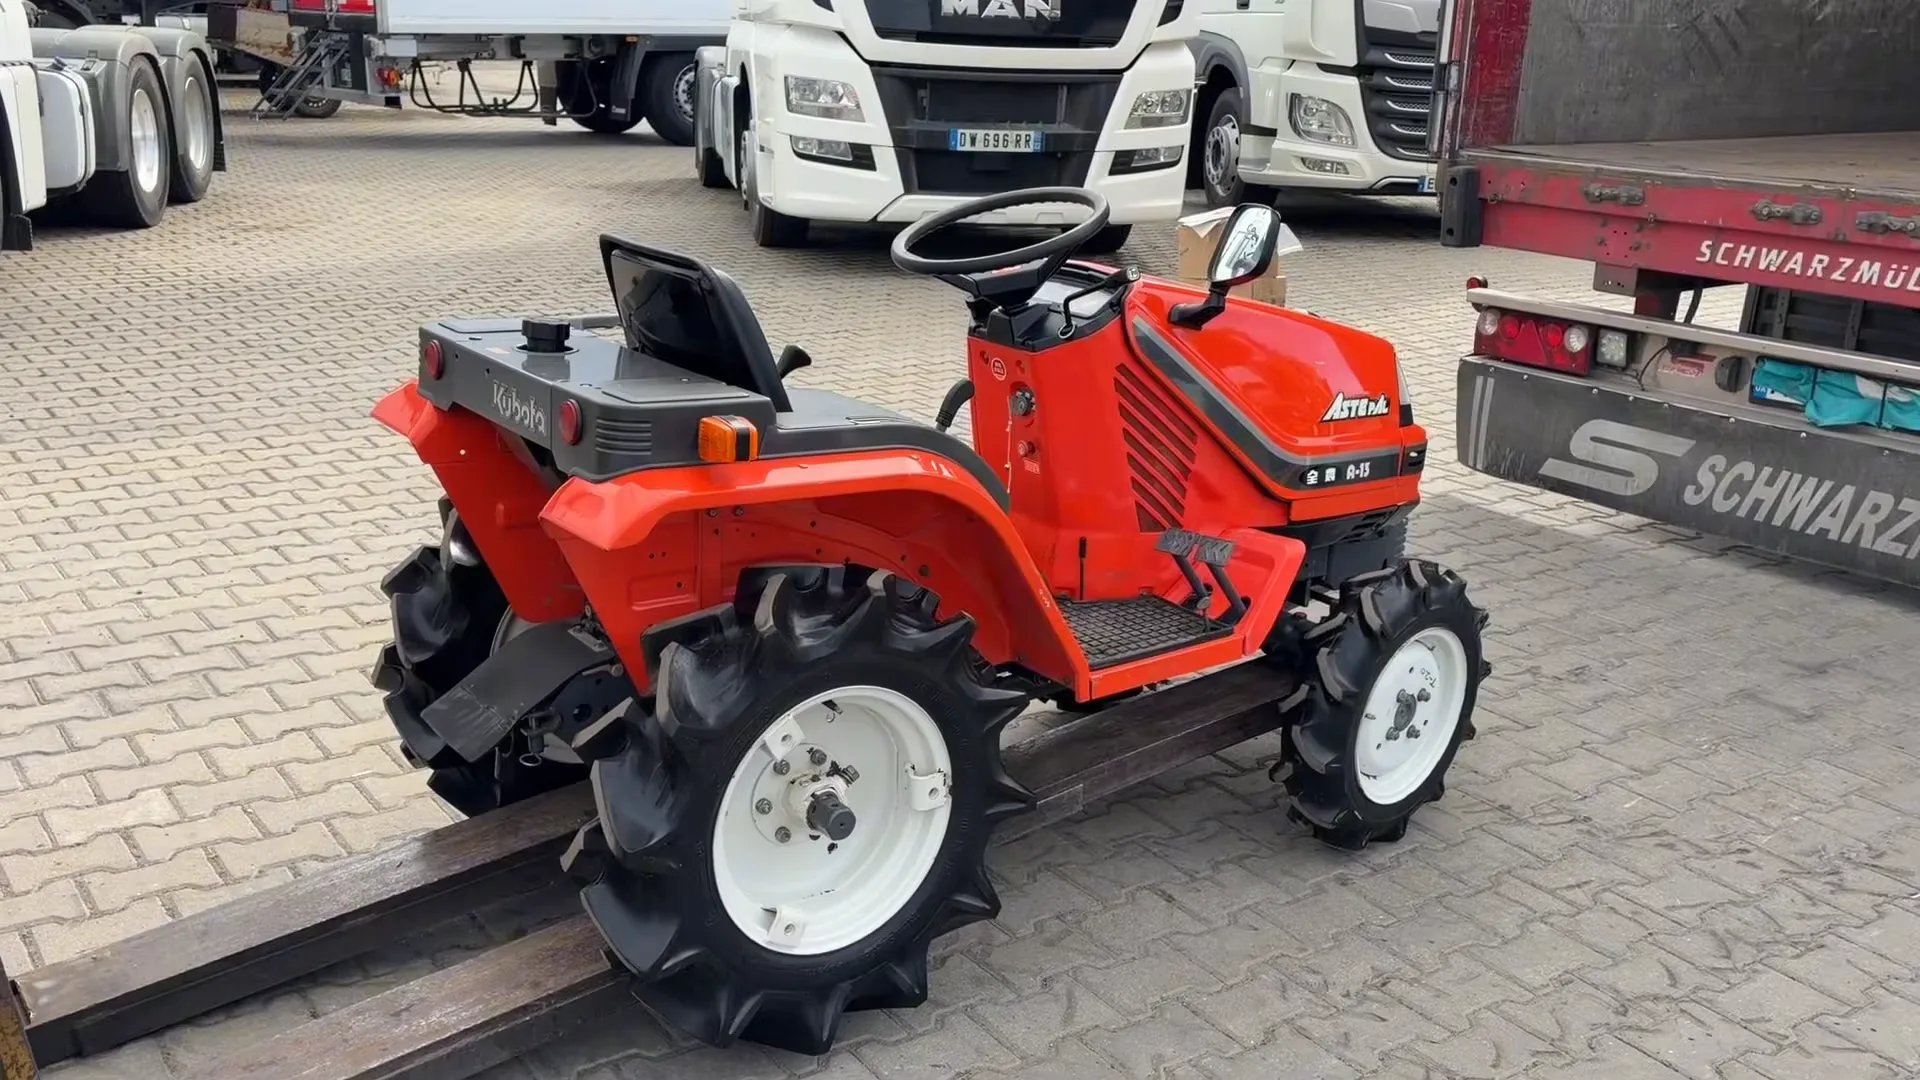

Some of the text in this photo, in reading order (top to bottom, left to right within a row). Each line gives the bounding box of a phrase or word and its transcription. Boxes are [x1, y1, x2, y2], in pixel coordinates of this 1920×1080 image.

[941, 0, 1061, 19] MAN
[960, 132, 977, 148] DW
[983, 133, 1009, 148] 696
[1015, 134, 1031, 149] RR
[493, 379, 546, 436] Kubota
[1684, 455, 1920, 559] SCHWARZ
